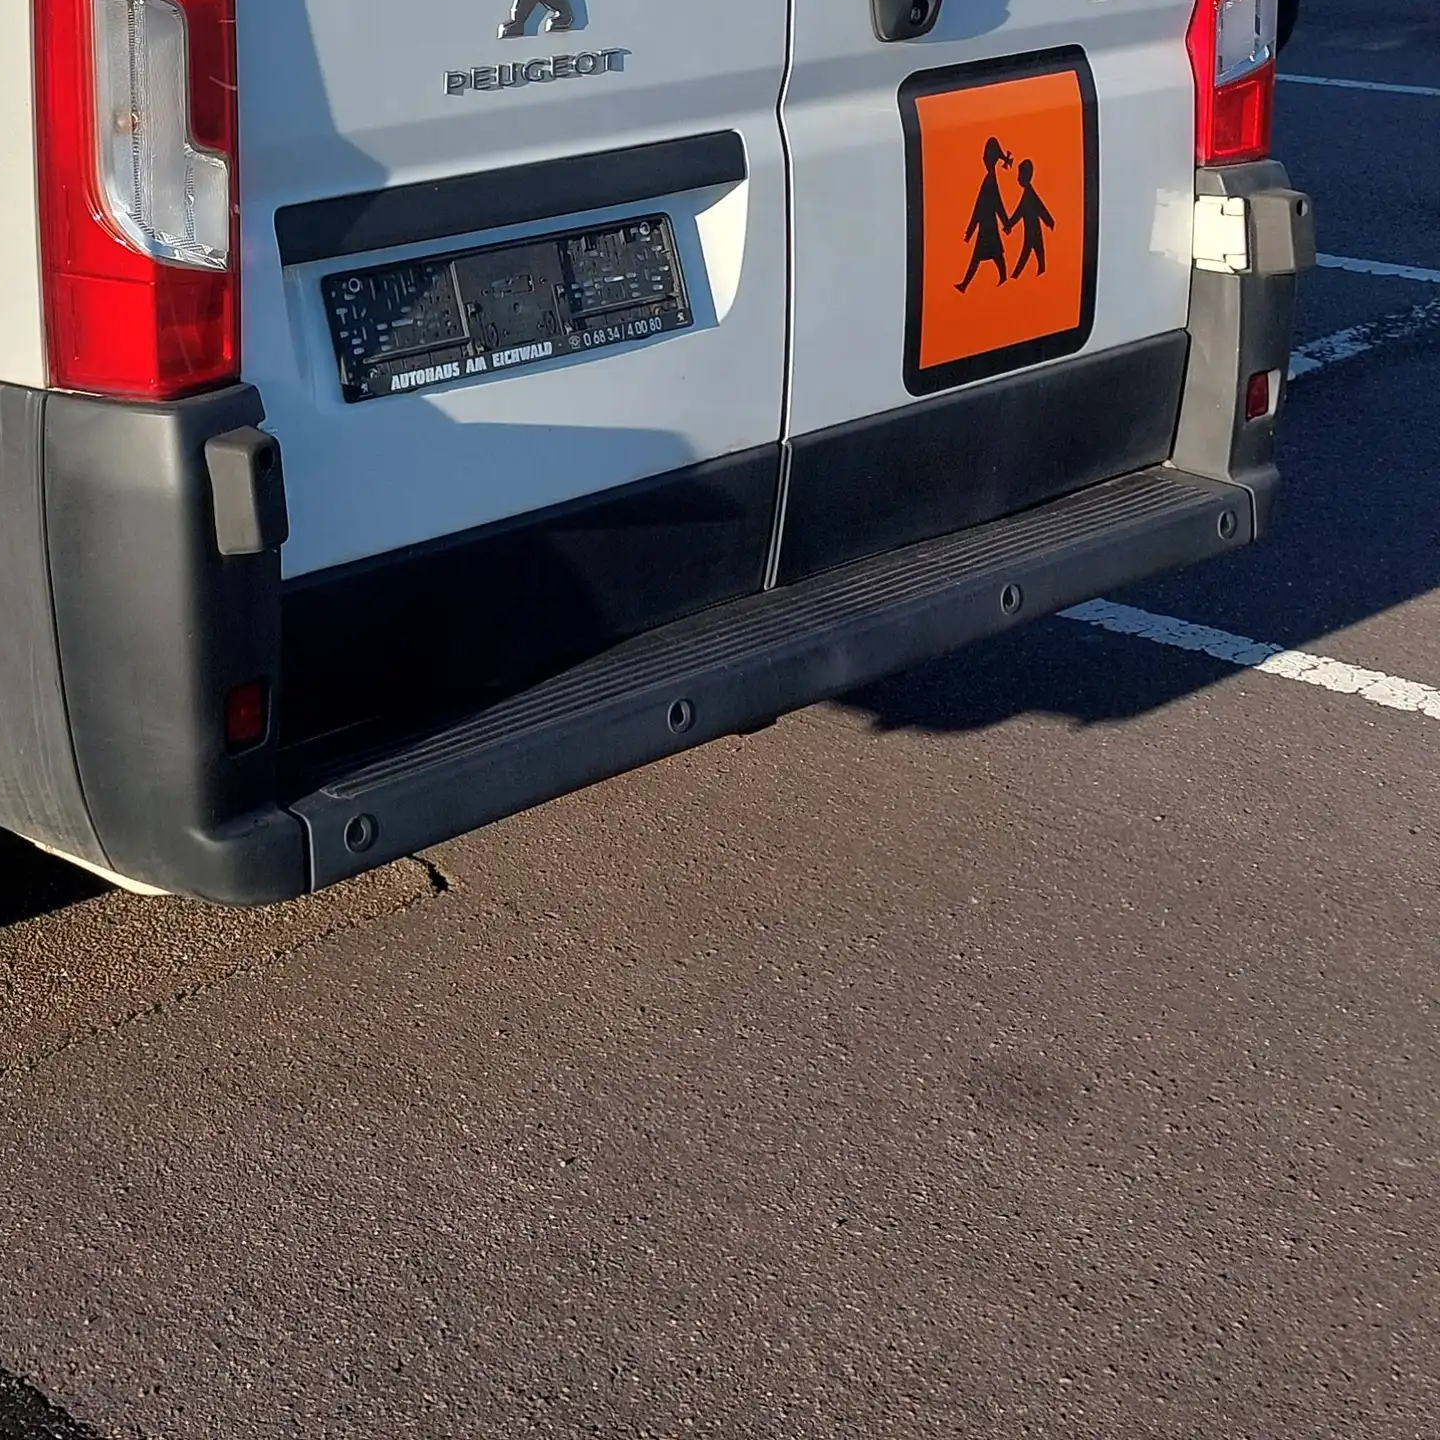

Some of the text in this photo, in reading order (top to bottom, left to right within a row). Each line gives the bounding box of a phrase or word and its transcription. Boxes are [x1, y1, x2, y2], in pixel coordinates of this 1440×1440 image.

[444, 48, 630, 94] PEUGEOT
[391, 362, 460, 391] AUTOHAUS
[466, 358, 487, 374] AM
[492, 341, 553, 367] EICHWALD
